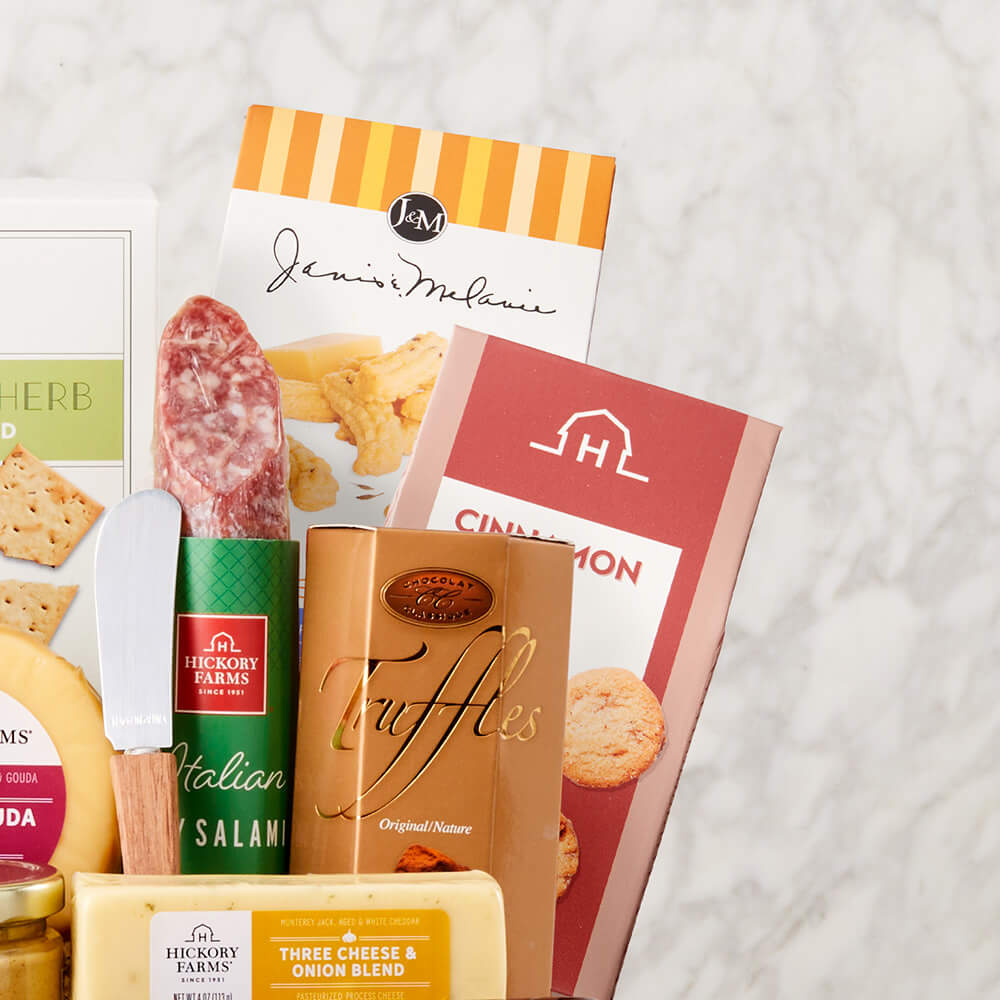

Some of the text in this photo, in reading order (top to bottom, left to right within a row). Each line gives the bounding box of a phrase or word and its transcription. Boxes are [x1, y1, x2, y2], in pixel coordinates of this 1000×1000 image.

[393, 198, 442, 233] J&M
[398, 253, 556, 314] Melanie
[455, 509, 642, 586] CINMON
[185, 656, 259, 671] HICKORY
[194, 671, 249, 685] FARMS
[198, 688, 224, 696] SINCE
[315, 625, 542, 820] Truffles
[6, 772, 38, 784] GOUDA
[196, 818, 286, 847] SALAMI
[379, 818, 472, 835] Original/Nature
[166, 947, 239, 959] HICKORY
[280, 946, 417, 961] THREE CHEESE &
[176, 961, 229, 973] FARMS
[292, 963, 405, 978] ONION BLEND
[296, 991, 404, 1000] PASTEURIZED PROCESS CHEESE
